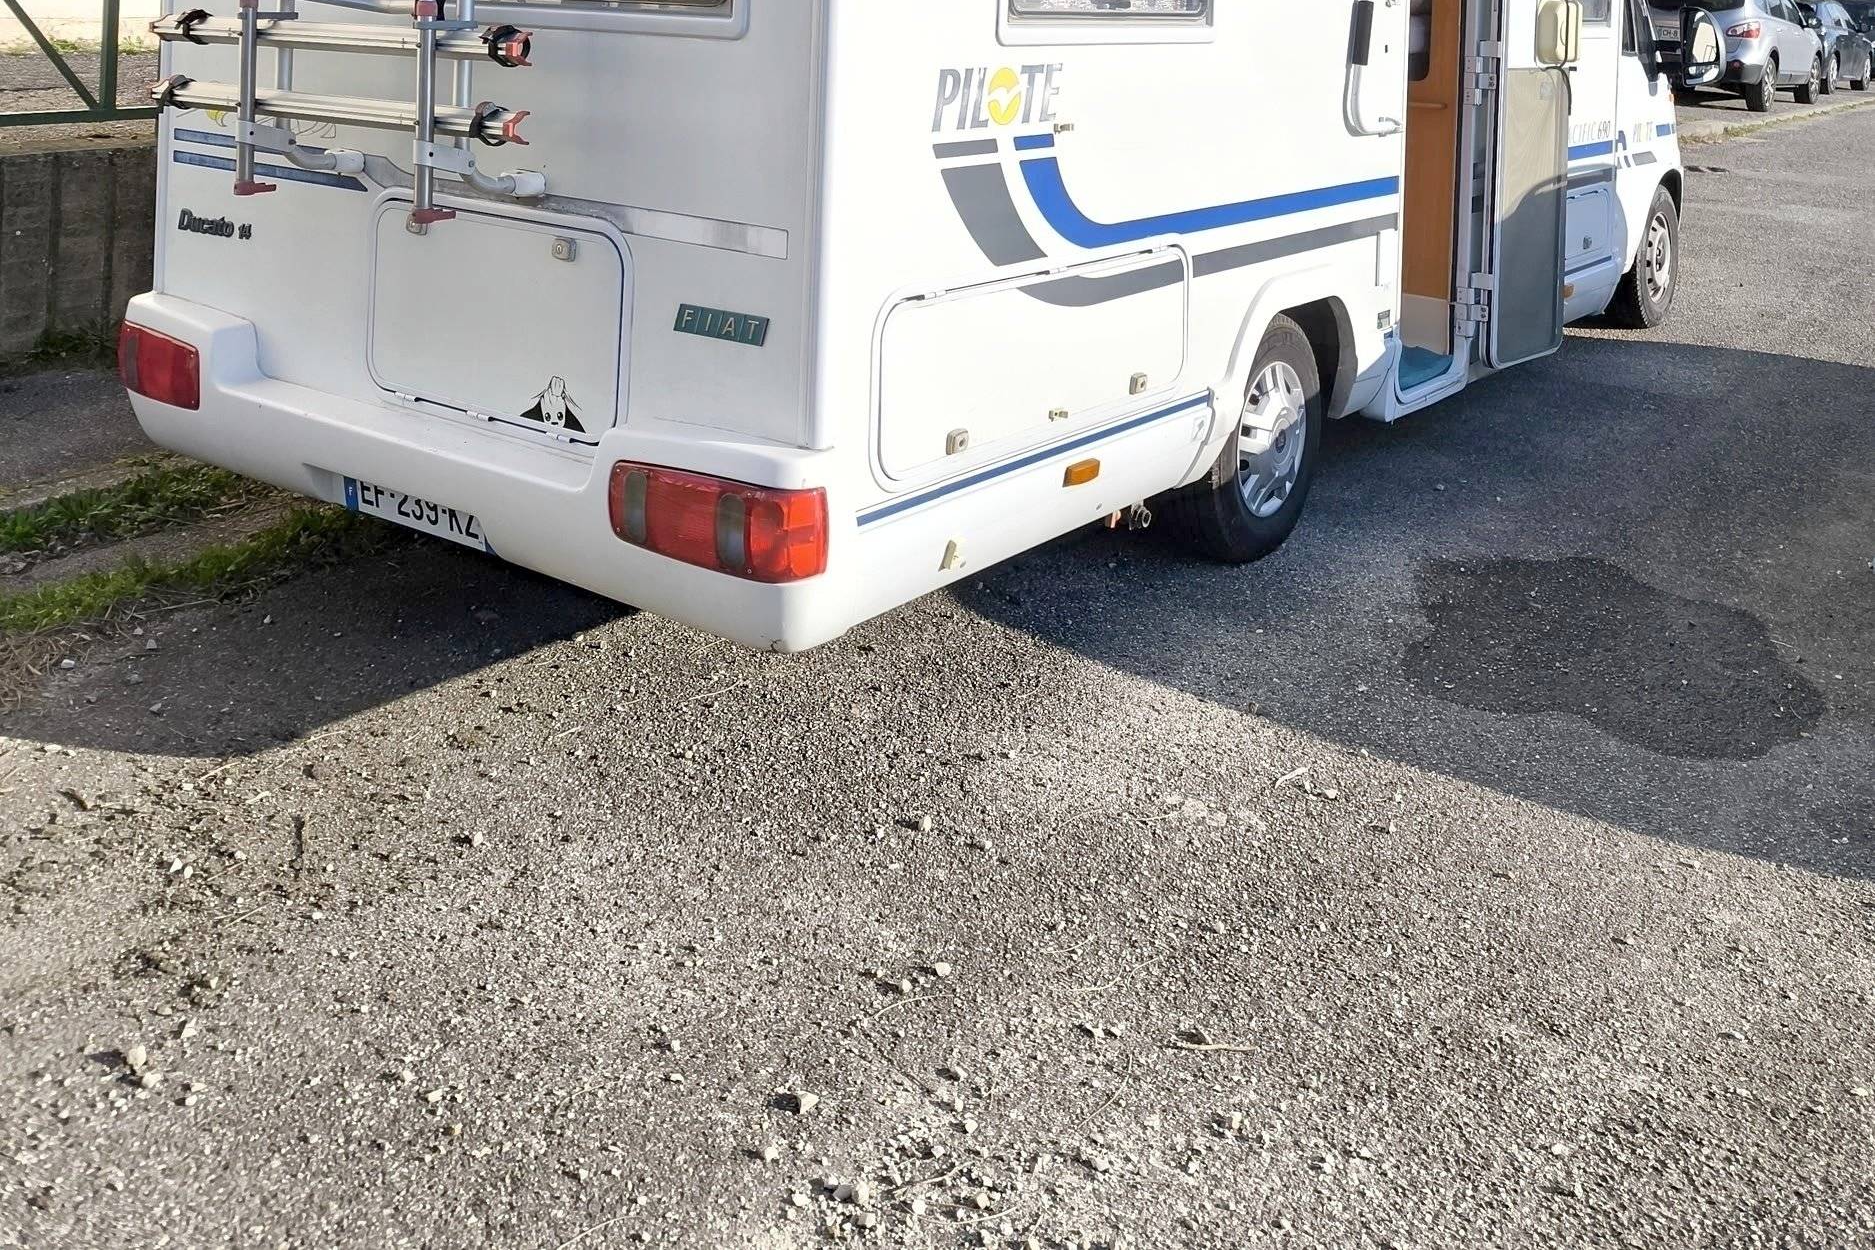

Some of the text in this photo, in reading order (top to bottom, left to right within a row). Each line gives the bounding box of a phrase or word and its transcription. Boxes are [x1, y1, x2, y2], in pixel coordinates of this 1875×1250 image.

[931, 63, 1063, 132] PILOTE
[178, 207, 252, 240] Ducato 14
[681, 309, 760, 340] FIAT
